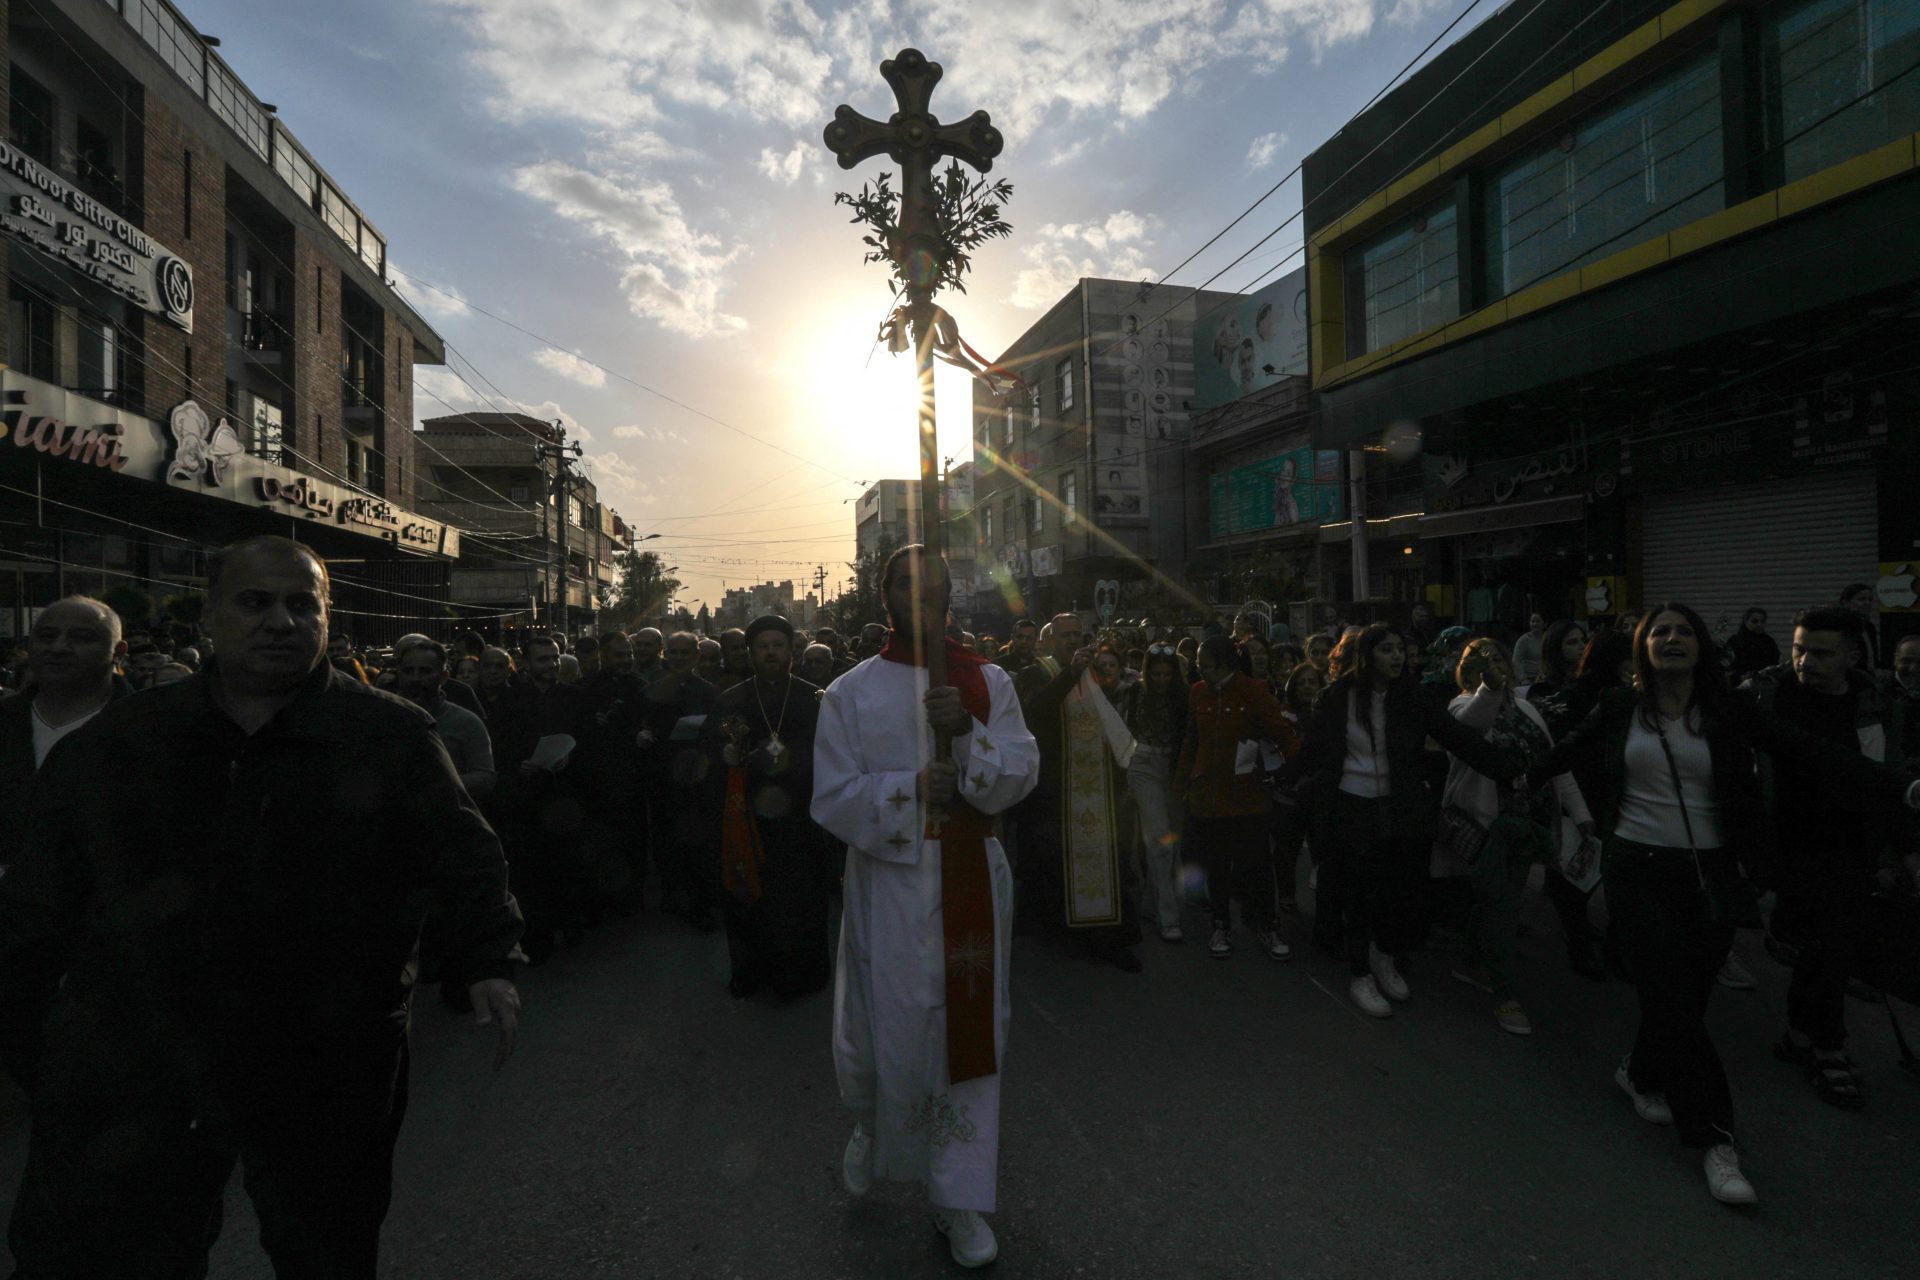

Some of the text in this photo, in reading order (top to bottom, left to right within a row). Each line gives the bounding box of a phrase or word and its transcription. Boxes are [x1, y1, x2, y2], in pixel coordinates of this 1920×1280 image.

[19, 195, 55, 227] ستو
[73, 191, 113, 231] Sitto
[116, 220, 157, 259] Clinic
[64, 222, 88, 247] نور
[92, 240, 136, 275] الدكتور
[14, 391, 128, 472] iami
[1661, 429, 1752, 463] STORE
[1792, 446, 1823, 459] MOBILE
